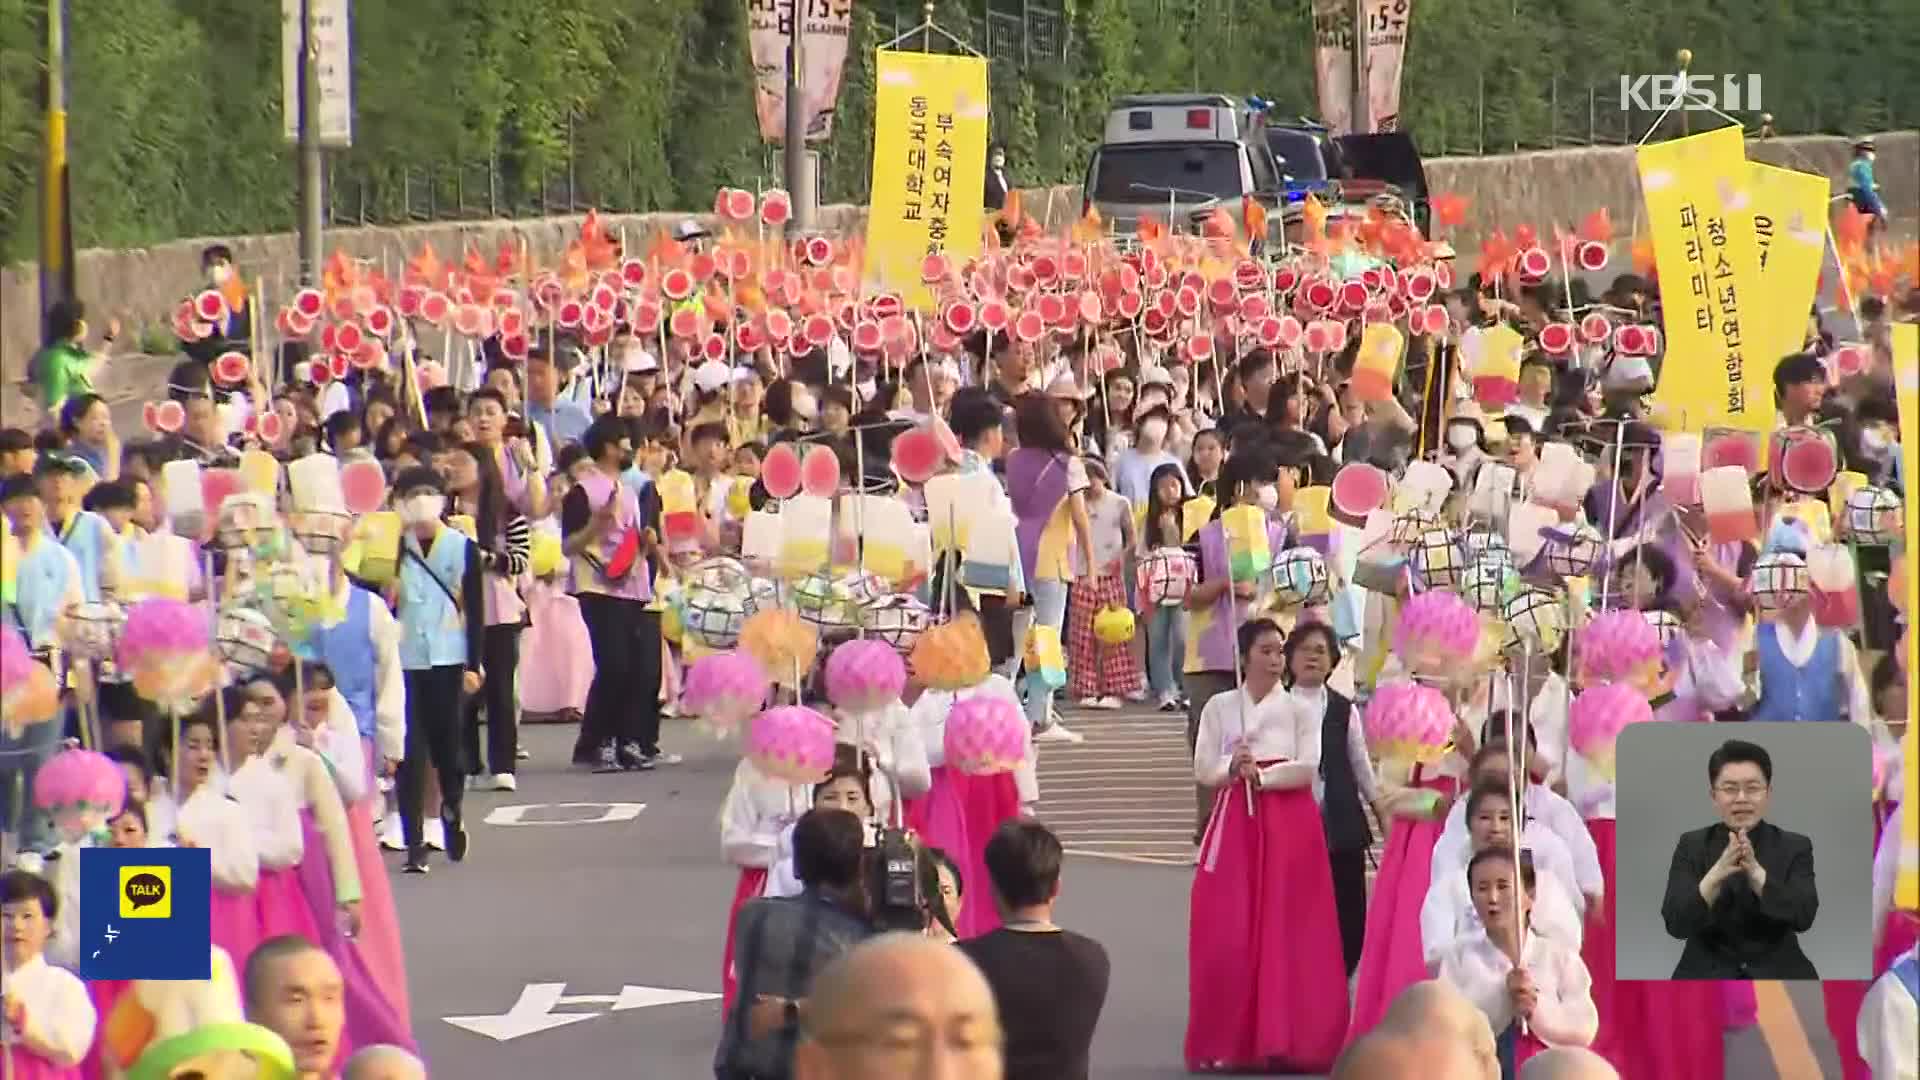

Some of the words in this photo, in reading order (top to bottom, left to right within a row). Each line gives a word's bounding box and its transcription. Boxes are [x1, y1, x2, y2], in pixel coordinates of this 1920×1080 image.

[903, 95, 928, 221] 동국대학교
[1679, 202, 1713, 333] 파라미타
[1707, 217, 1744, 414] 청소년연합회
